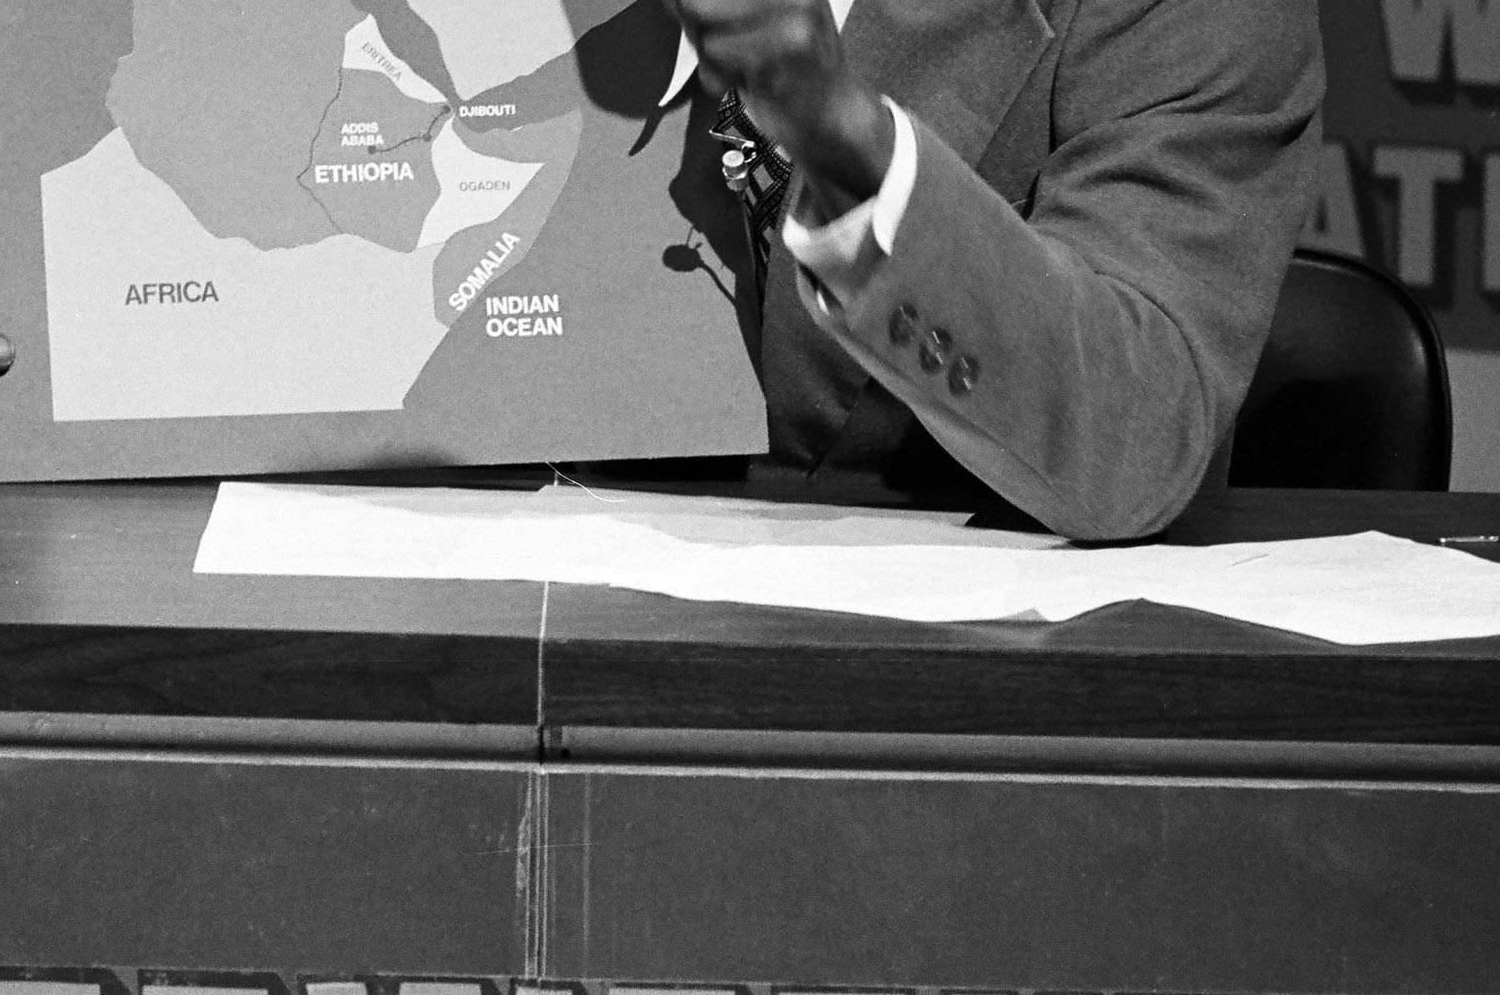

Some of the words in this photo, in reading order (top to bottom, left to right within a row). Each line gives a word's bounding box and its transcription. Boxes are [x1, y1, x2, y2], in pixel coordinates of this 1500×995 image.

[459, 104, 516, 118] DJIBOUTI
[341, 122, 379, 135] ADDIS
[341, 135, 385, 147] ABABA
[314, 161, 414, 184] ETHIOPIA
[459, 180, 511, 193] OGADEN
[449, 231, 521, 311] SOMALIA
[124, 280, 220, 306] AFRICA
[485, 294, 560, 316] INDIAN
[485, 316, 563, 338] OCEAN
